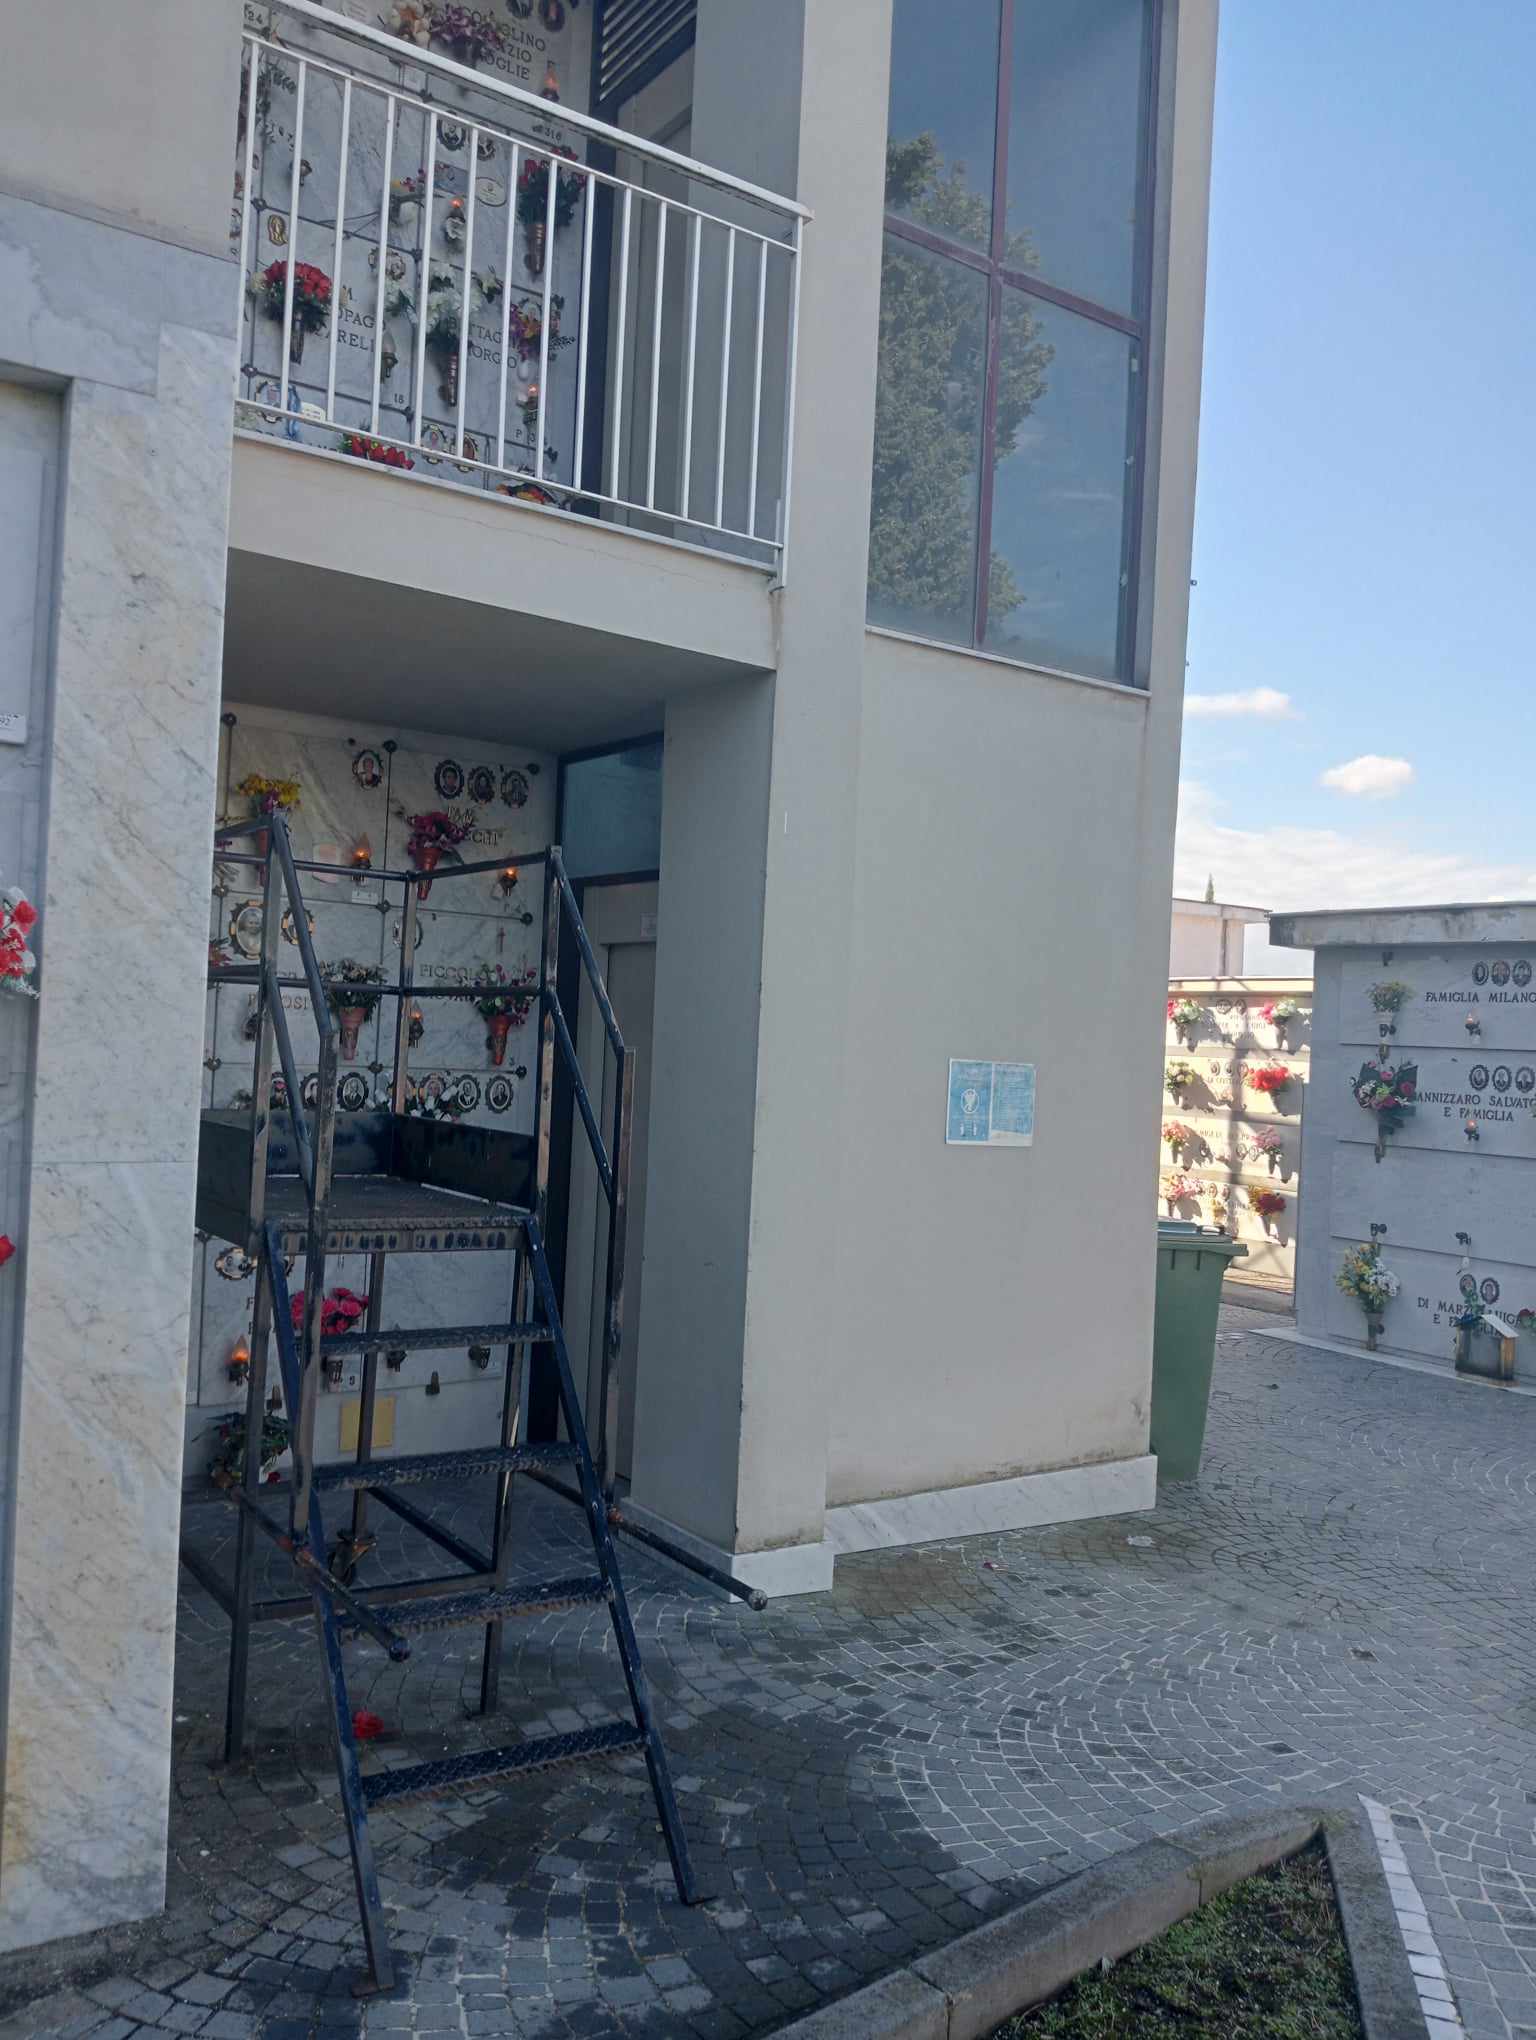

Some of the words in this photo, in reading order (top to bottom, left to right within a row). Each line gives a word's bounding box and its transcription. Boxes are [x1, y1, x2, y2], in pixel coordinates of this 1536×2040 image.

[1425, 991, 1480, 1003] FAMIGLIA
[1417, 1091, 1481, 1105] ANNIZZARO
[1443, 1106, 1452, 1117] E
[1459, 1107, 1514, 1122] FAMIGLIA
[1417, 1296, 1429, 1309] DI
[1433, 1313, 1441, 1324] E
